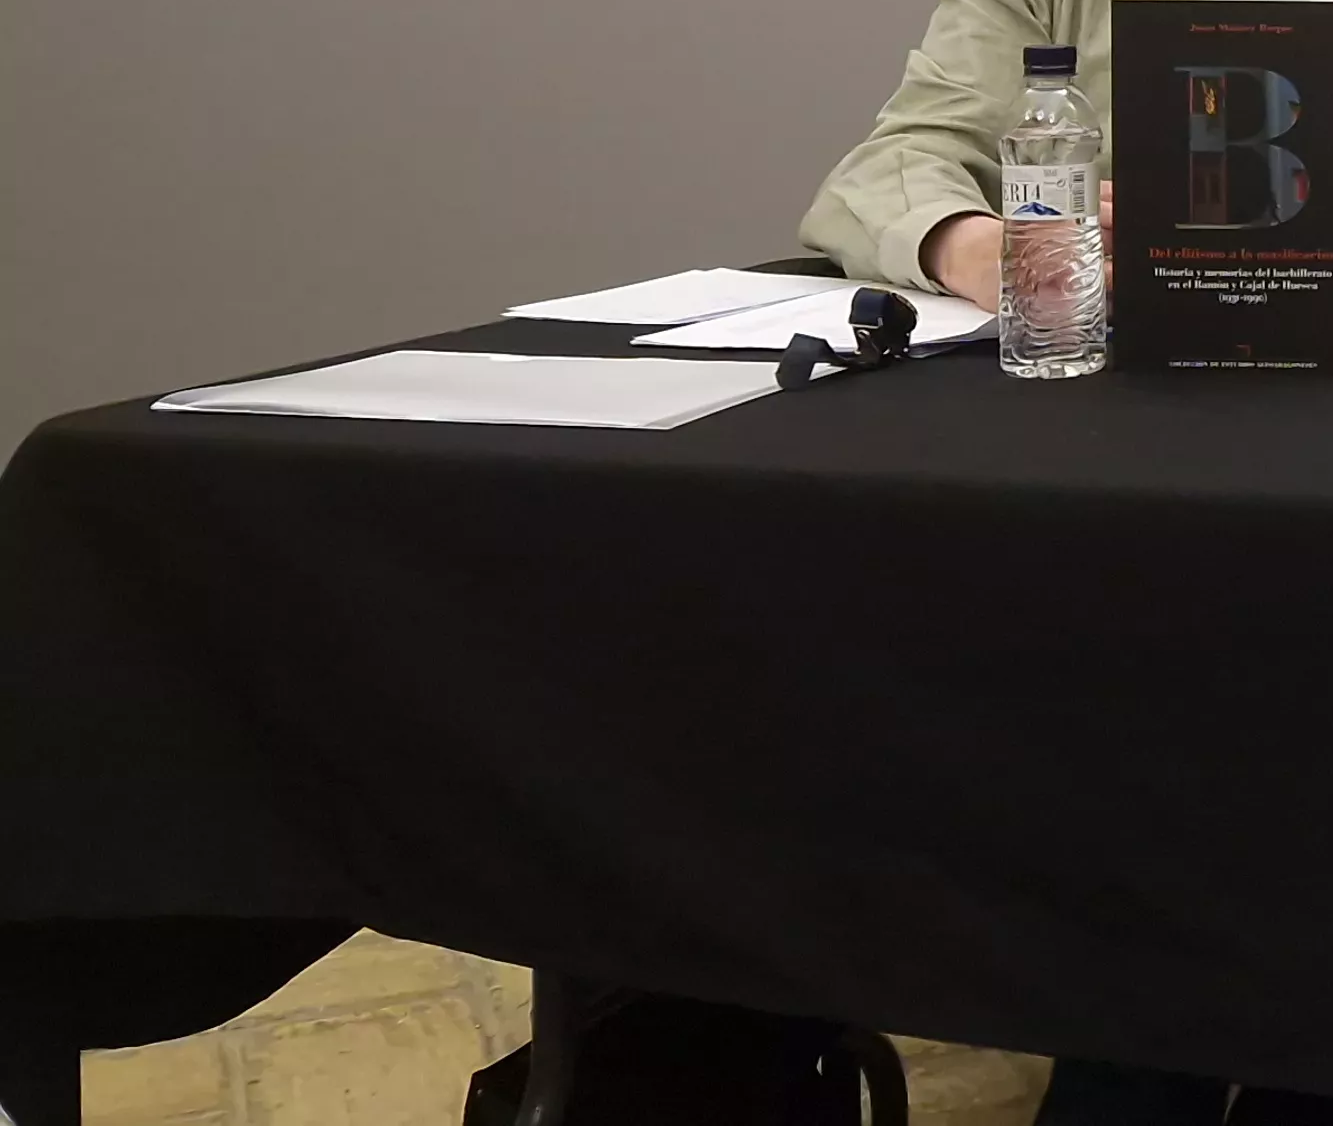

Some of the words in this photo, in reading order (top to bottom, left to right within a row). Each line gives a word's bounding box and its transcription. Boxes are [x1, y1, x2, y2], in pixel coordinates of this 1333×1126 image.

[1174, 66, 1310, 229] B
[1149, 247, 1170, 259] Del
[1229, 252, 1236, 260] a
[1154, 267, 1194, 277] Historia
[1196, 271, 1202, 280] y
[1204, 268, 1252, 278] memorias
[1255, 268, 1271, 278] del
[1273, 268, 1333, 279] bachillerato
[1182, 280, 1192, 289] el
[1231, 282, 1237, 292] y
[1239, 279, 1266, 292] Cajal
[1268, 280, 1280, 290] de
